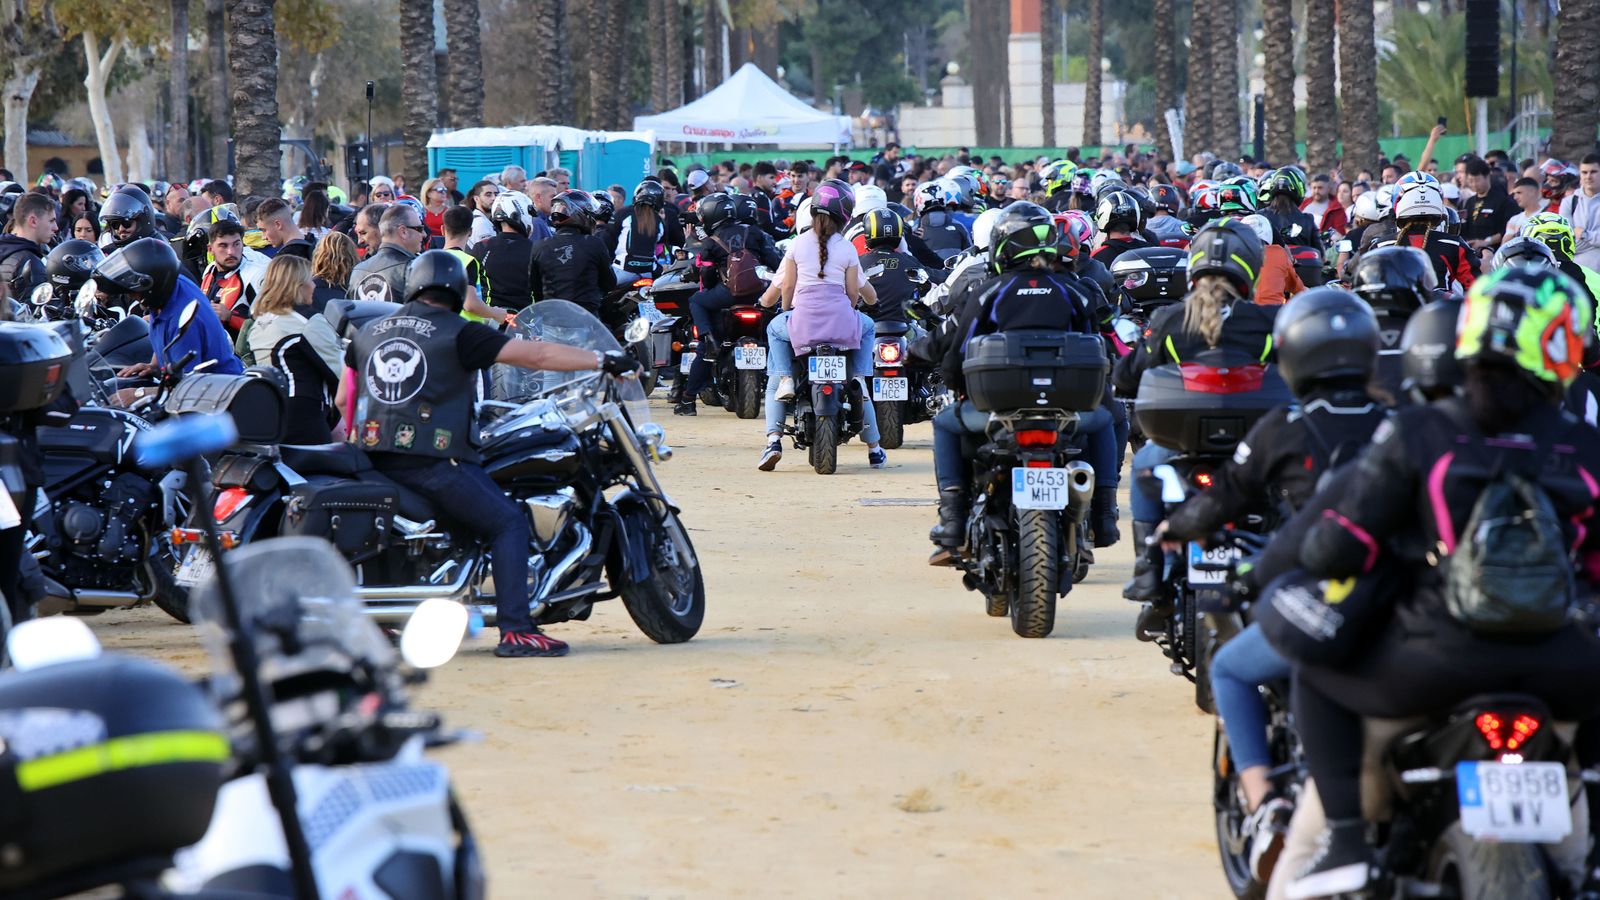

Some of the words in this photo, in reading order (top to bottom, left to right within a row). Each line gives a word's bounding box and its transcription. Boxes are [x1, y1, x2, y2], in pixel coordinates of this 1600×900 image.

[742, 348, 765, 357] 5870
[745, 357, 762, 366] MCC
[817, 357, 844, 368] 7645
[817, 369, 838, 379] LMG
[881, 379, 906, 389] 7859
[881, 389, 900, 399] HCC
[1026, 470, 1065, 486] 6453
[1031, 487, 1060, 502] MHT
[1485, 767, 1562, 797] 6958
[1488, 801, 1543, 827] LWV
